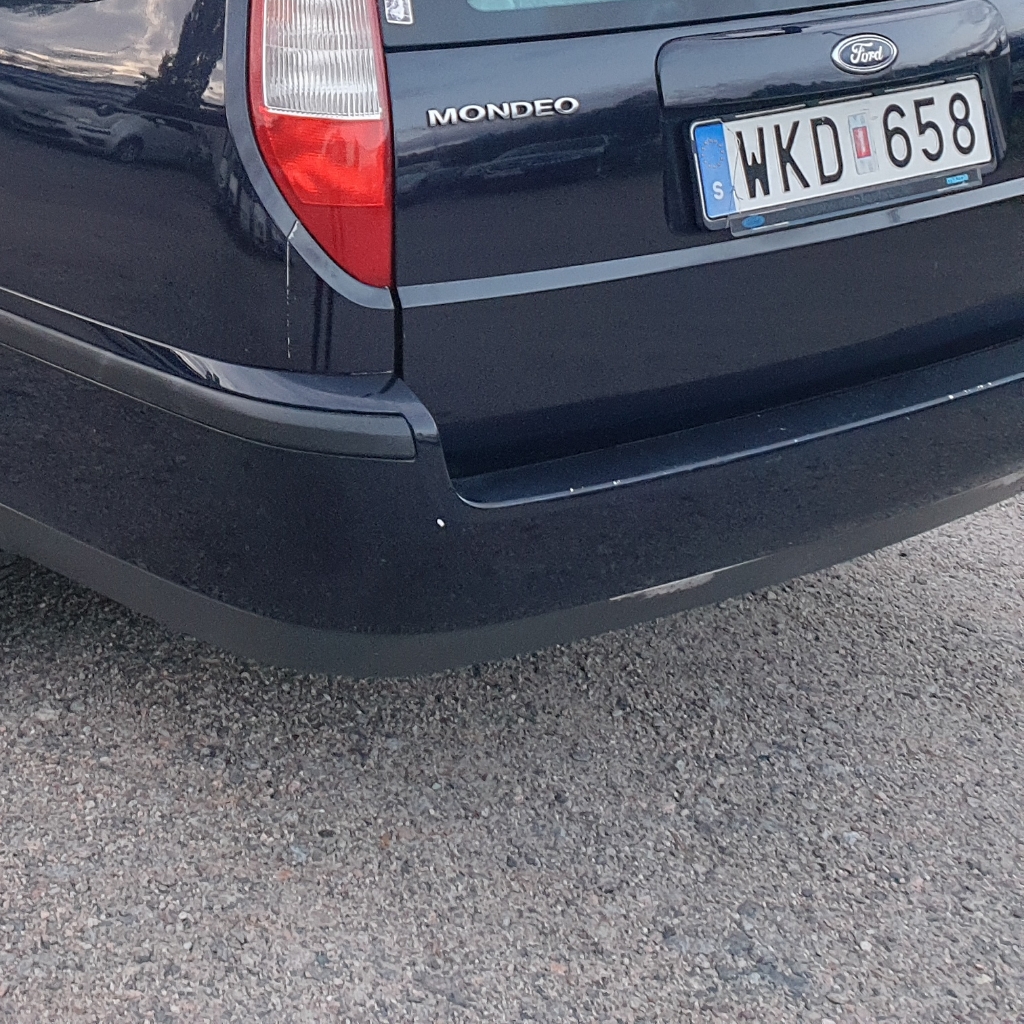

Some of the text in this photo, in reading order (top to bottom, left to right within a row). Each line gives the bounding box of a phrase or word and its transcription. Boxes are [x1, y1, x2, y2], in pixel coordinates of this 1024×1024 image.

[850, 42, 883, 64] Ford
[427, 96, 580, 127] MONDEO
[736, 92, 976, 199] WKD 658
[712, 180, 725, 200] S
